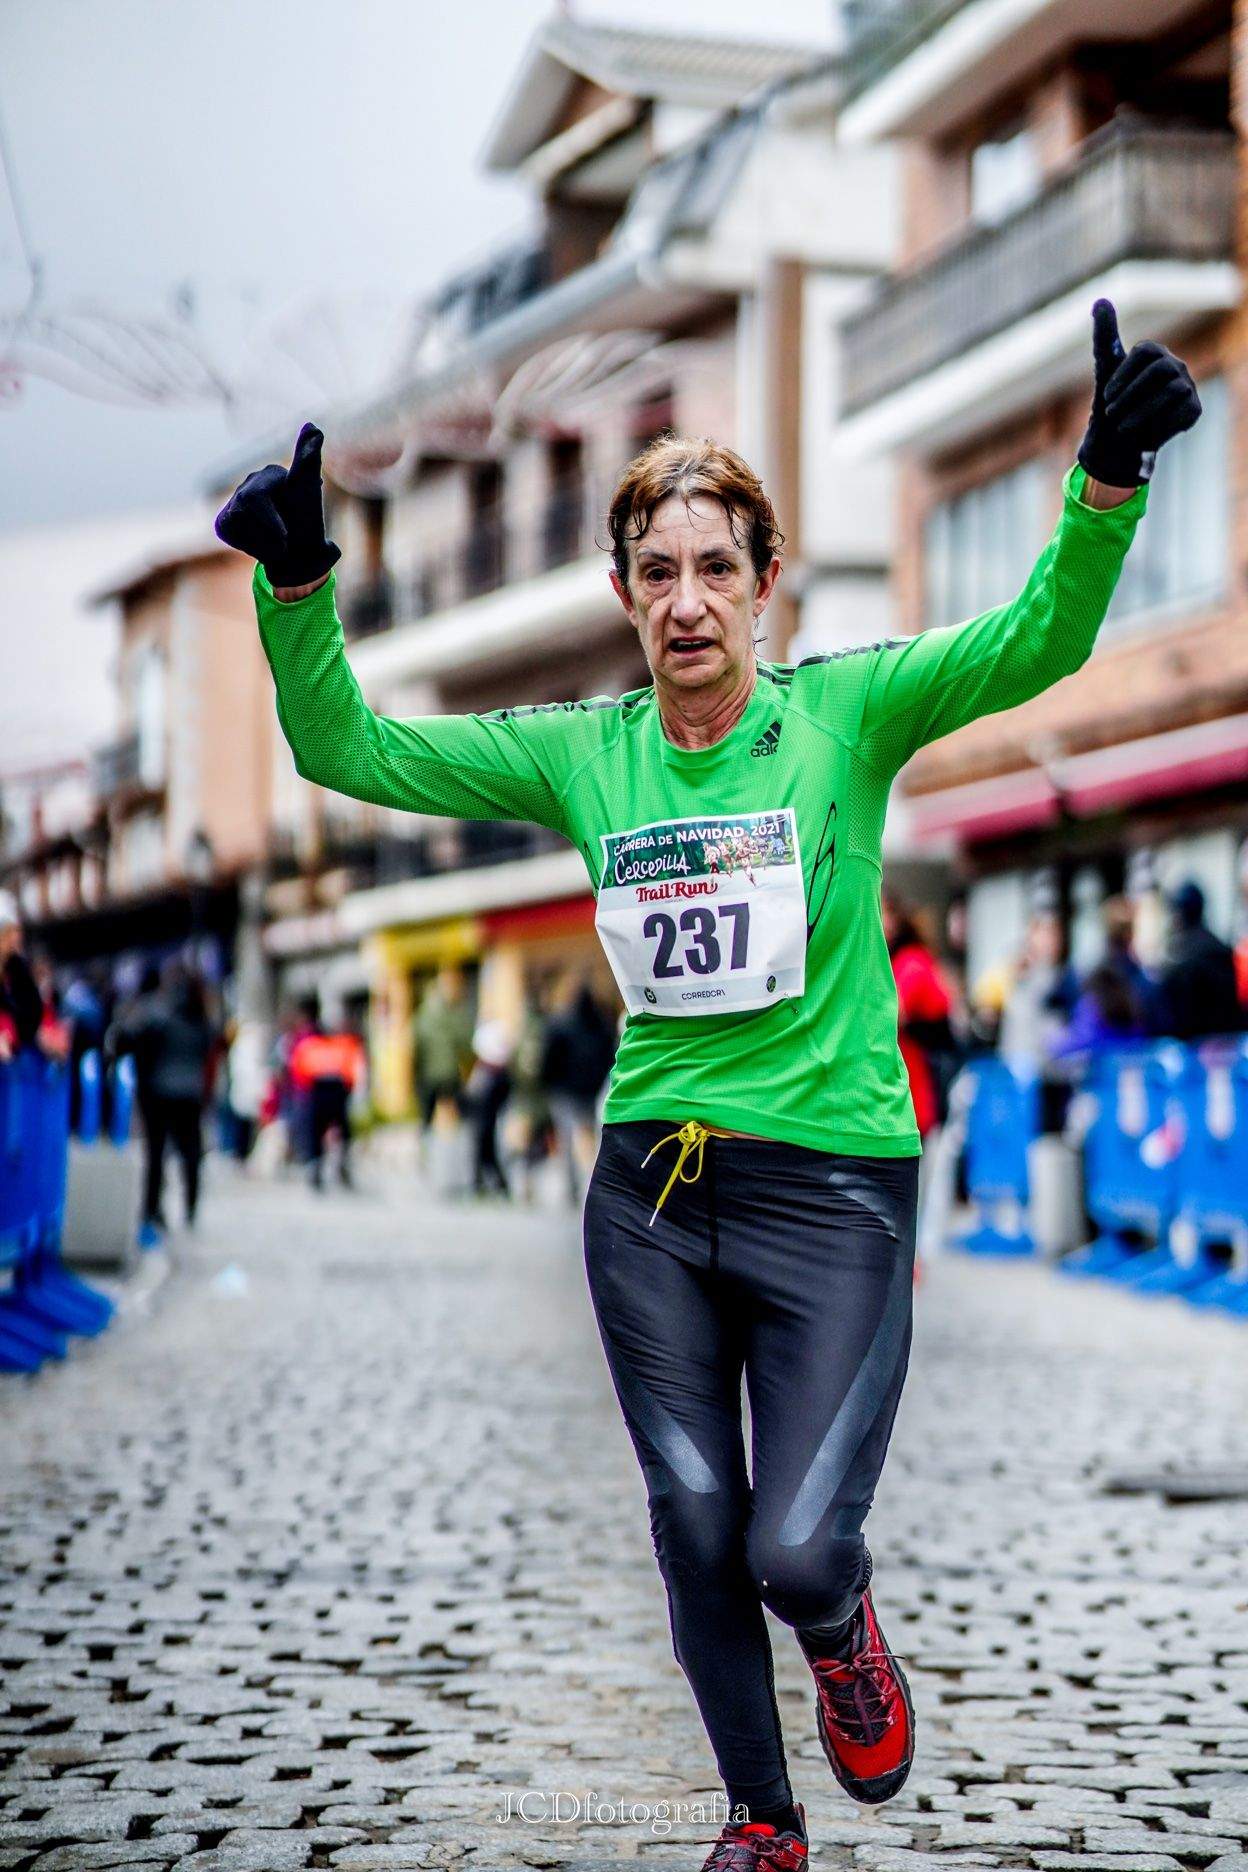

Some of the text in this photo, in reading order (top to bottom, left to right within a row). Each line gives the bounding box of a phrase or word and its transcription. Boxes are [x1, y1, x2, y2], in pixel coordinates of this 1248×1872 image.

[658, 834, 674, 846] DE
[676, 826, 745, 843] NAVIDAD
[750, 822, 780, 837] 2021
[636, 881, 718, 902] Trail Run
[643, 902, 750, 979] 237
